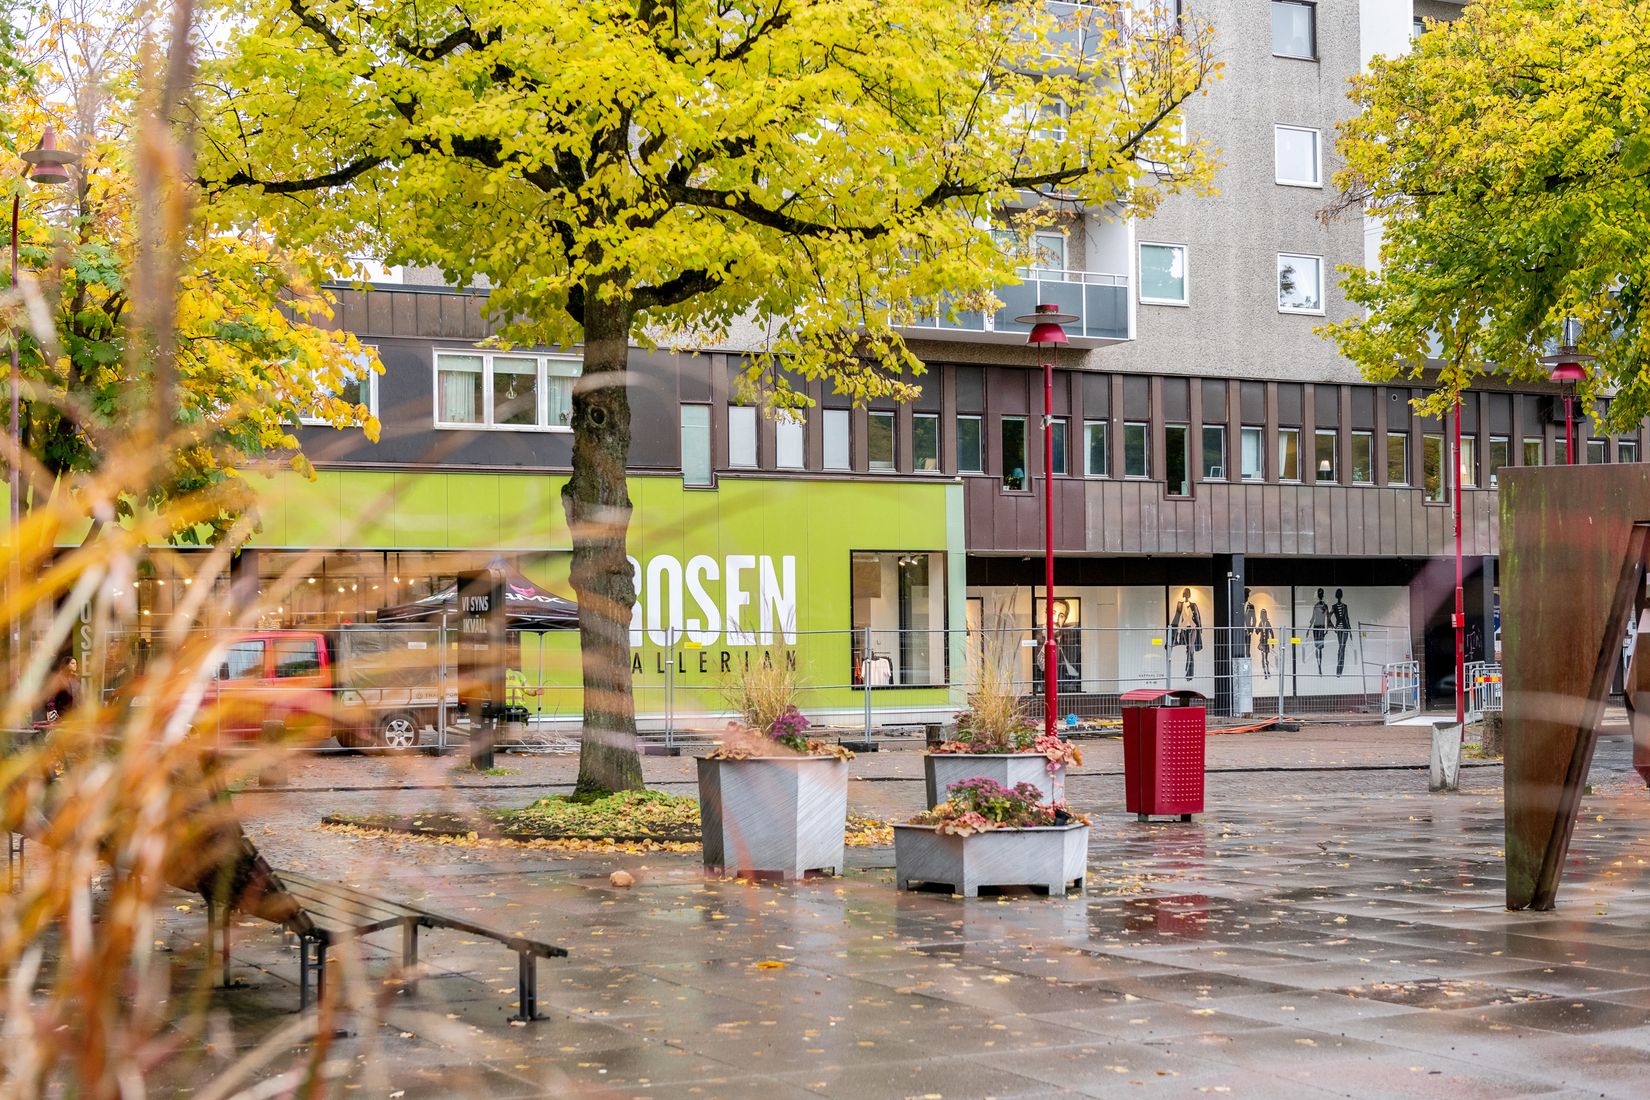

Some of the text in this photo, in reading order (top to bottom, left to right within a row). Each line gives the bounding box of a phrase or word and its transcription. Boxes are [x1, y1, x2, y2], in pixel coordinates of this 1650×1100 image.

[461, 596, 469, 611] VI
[470, 595, 489, 612] SYNS
[631, 650, 796, 674] ALLERIAN
